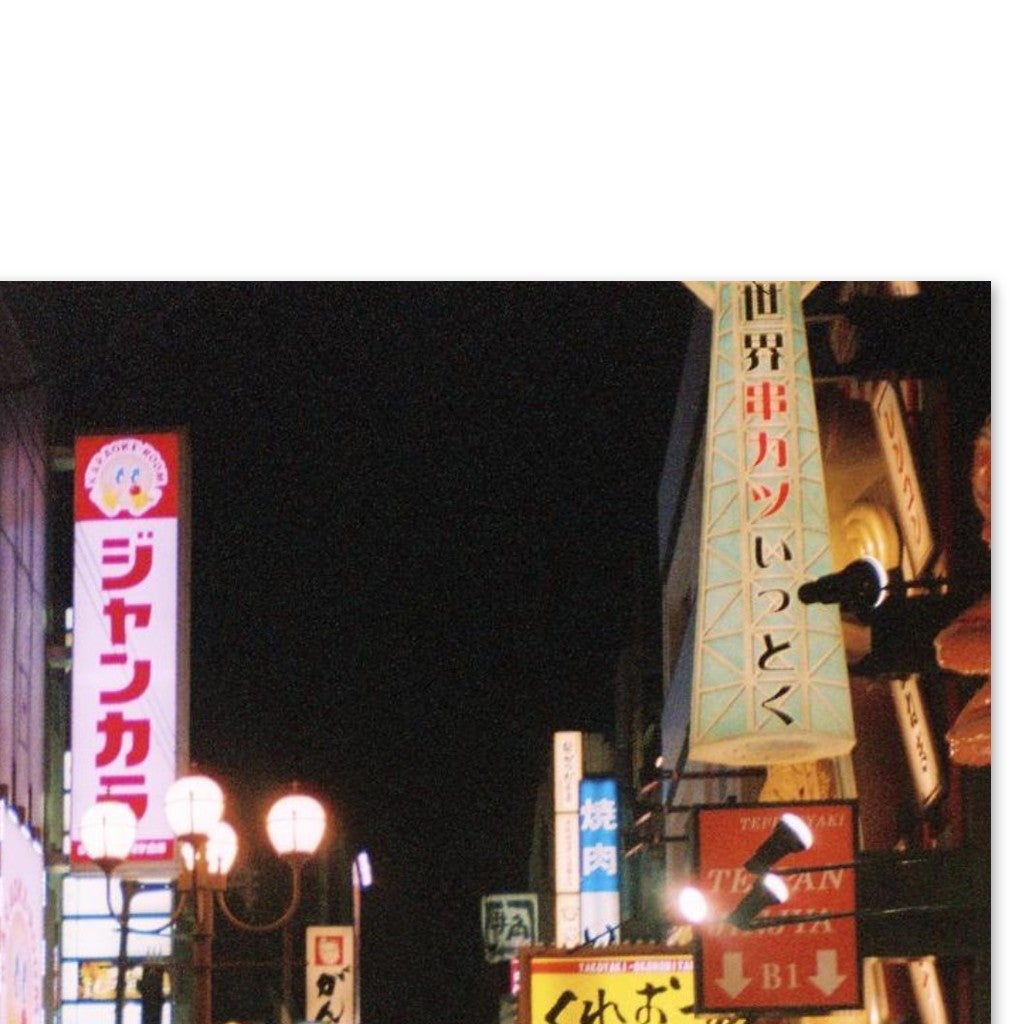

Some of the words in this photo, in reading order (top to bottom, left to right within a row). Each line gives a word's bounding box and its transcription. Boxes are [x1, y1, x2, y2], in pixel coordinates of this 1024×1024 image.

[94, 530, 154, 822] ジャンカラ
[579, 798, 618, 876] 焼肉
[708, 867, 845, 894] TEAN
[762, 962, 799, 991] B1
